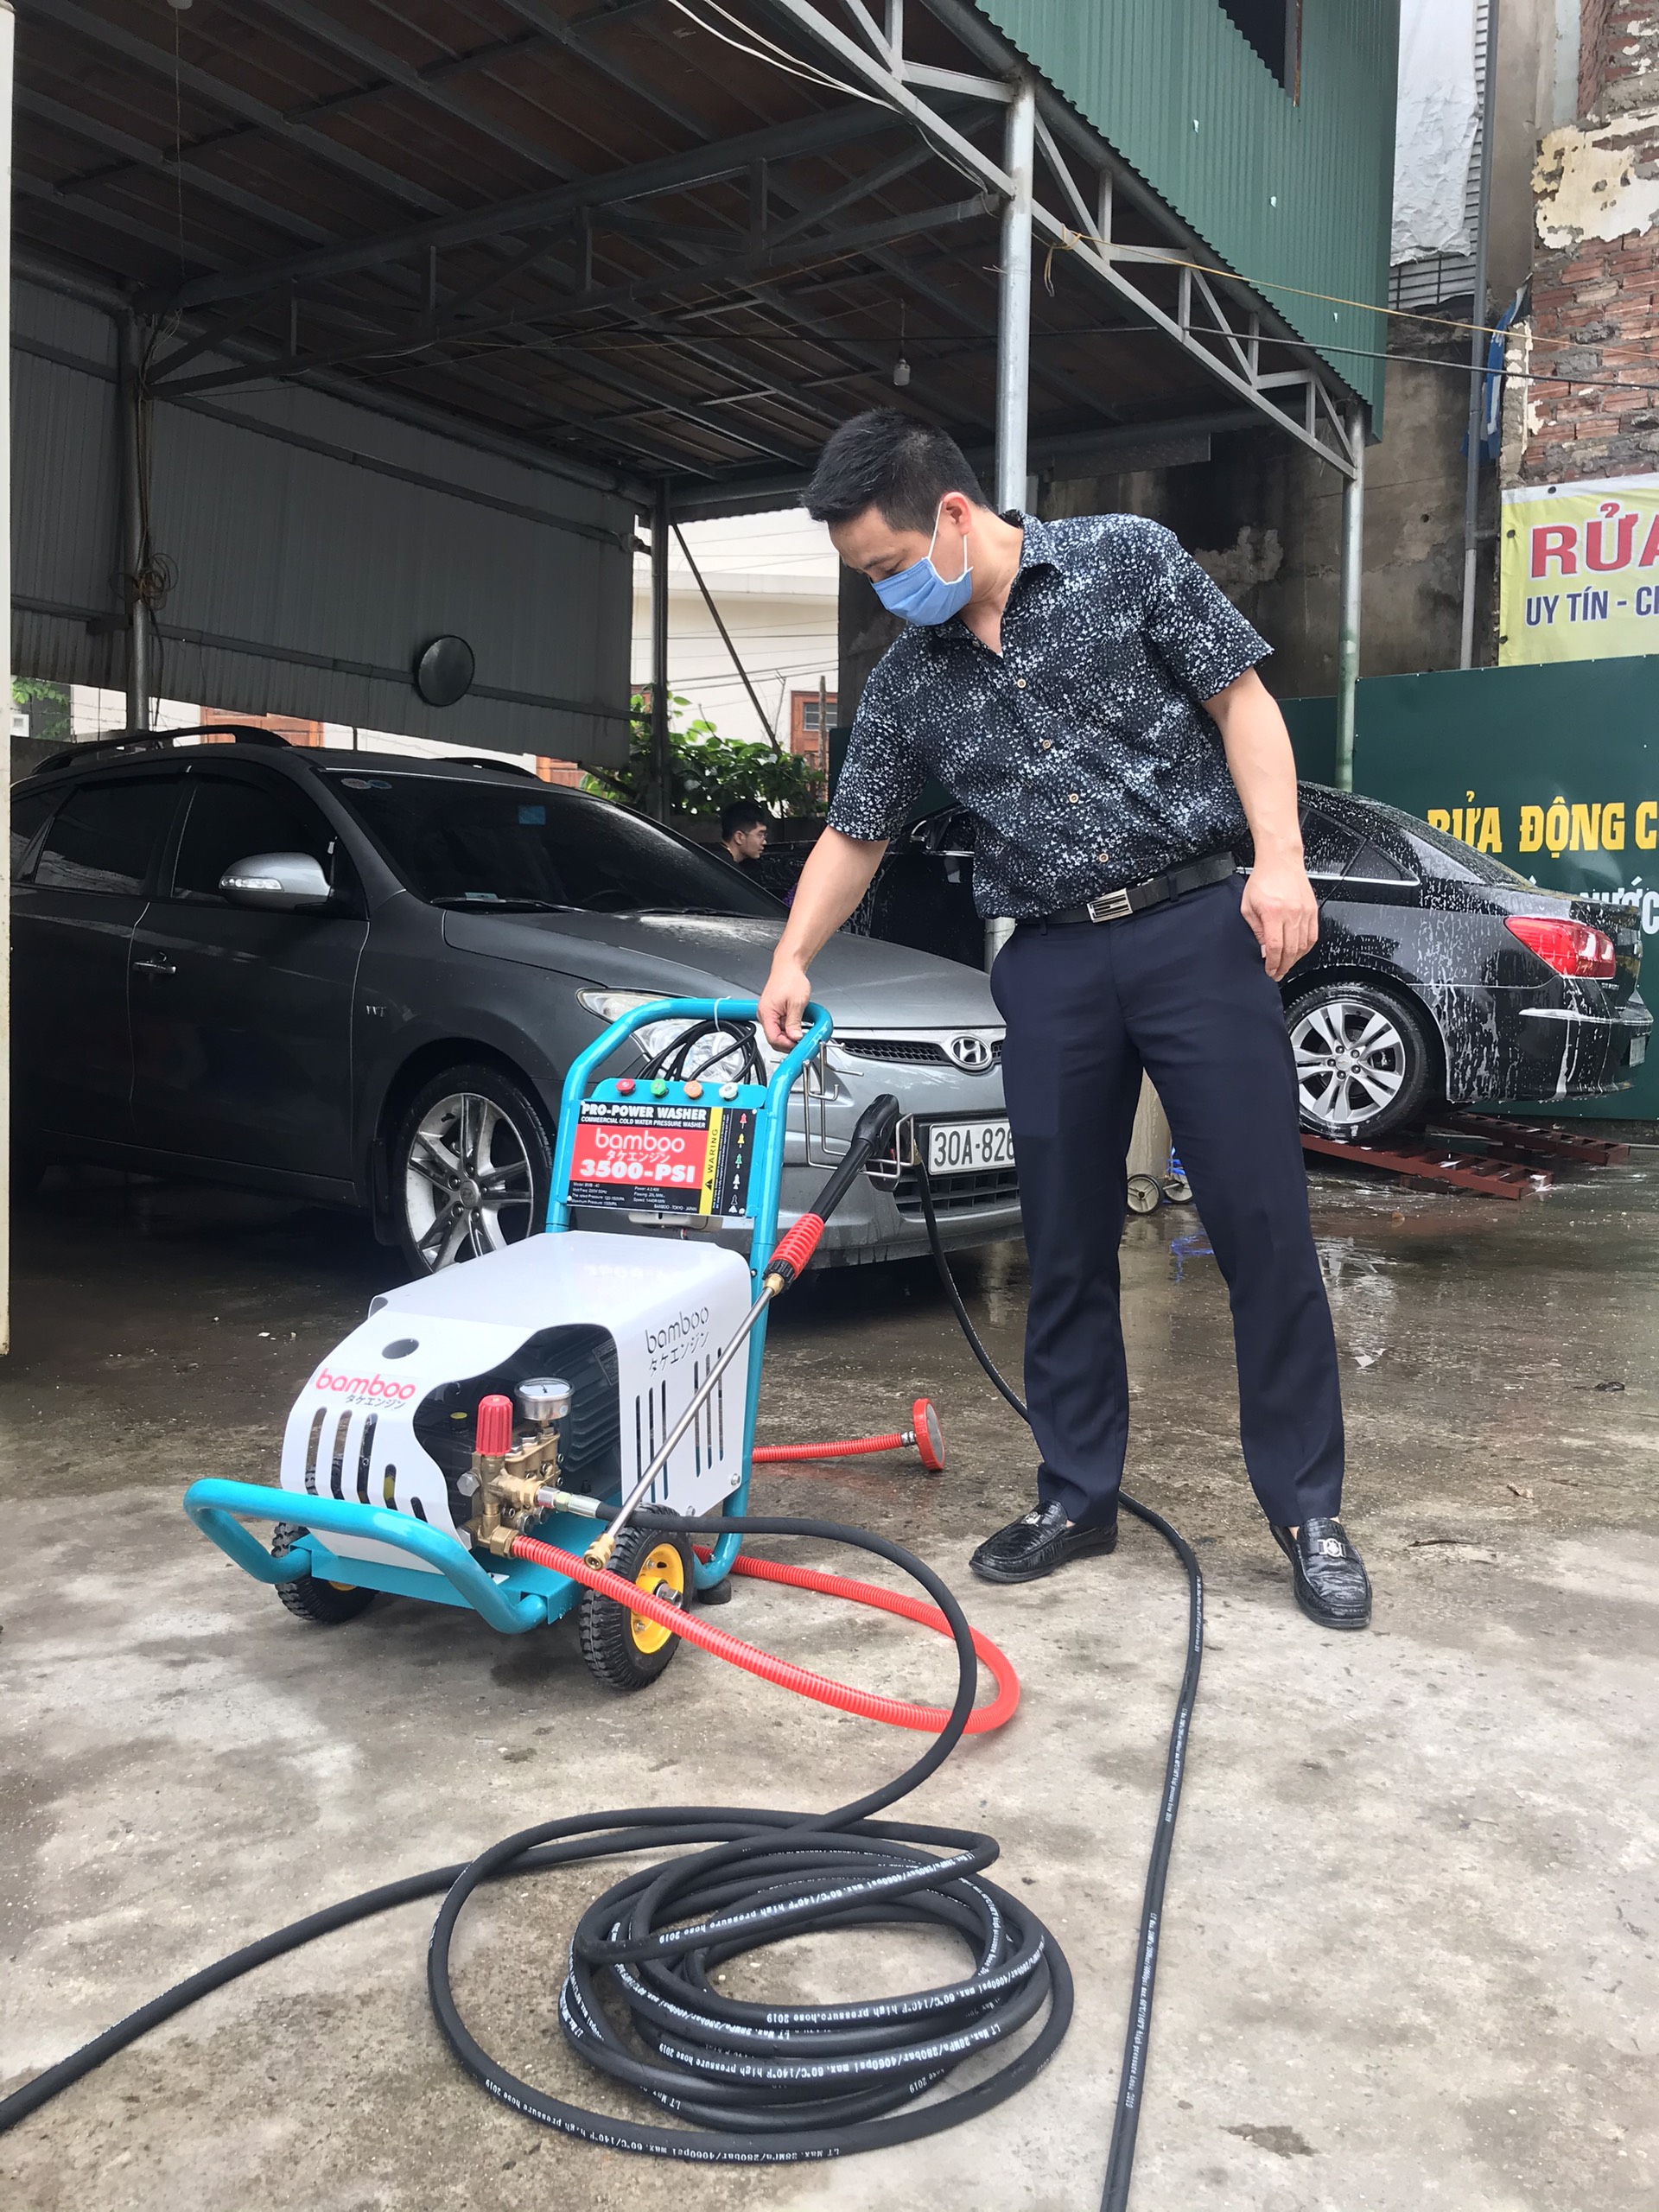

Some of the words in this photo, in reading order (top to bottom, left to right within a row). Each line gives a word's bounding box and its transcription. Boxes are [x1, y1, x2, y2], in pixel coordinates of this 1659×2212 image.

[1526, 594, 1560, 626] UY
[1567, 586, 1608, 622] TÍN
[1519, 796, 1625, 858] ĐỘNG
[582, 1103, 654, 1118] PRO-POWER
[657, 1107, 707, 1121] WASHER
[594, 1127, 685, 1154] bamboo
[607, 1149, 671, 1164] タケエンジン
[707, 1128, 719, 1173] WARING
[580, 1159, 696, 1183] 3500-PSI
[645, 1306, 709, 1354] bamboo
[649, 1332, 709, 1377] タケエンジン
[315, 1368, 416, 1400] bamboo
[346, 1394, 405, 1409] タケエンジン
[760, 1903, 785, 1916] high
[658, 1930, 681, 1944] 2019
[766, 2013, 790, 2023] 2019
[873, 2005, 897, 2020] high
[990, 2023, 1001, 2034] LT
[1132, 2031, 1143, 2044] high
[658, 2043, 675, 2059] 2019
[676, 2050, 693, 2065] hose
[1129, 2044, 1141, 2074] pressure
[695, 2057, 736, 2074] pressure
[740, 2065, 763, 2077] high
[484, 2078, 502, 2097] 2019
[909, 2076, 928, 2094] 2019
[503, 2091, 521, 2110] hose
[669, 2098, 681, 2110] LT
[1124, 2091, 1135, 2108] 2019
[522, 2103, 562, 2128] pressure
[564, 2122, 586, 2138] high
[827, 2148, 840, 2157] LT
